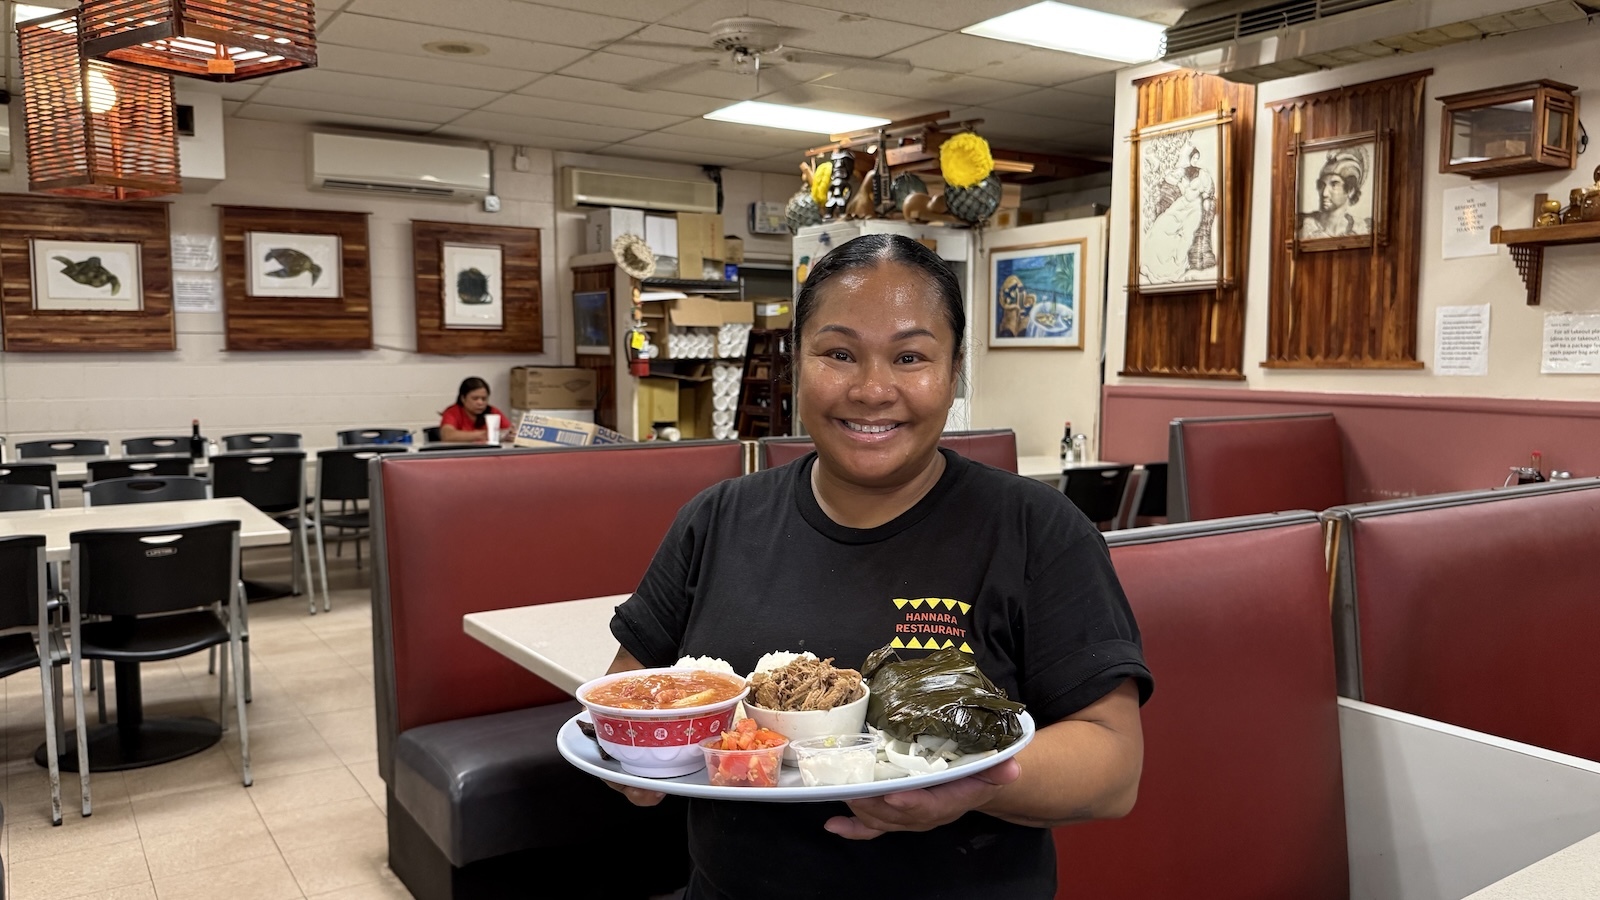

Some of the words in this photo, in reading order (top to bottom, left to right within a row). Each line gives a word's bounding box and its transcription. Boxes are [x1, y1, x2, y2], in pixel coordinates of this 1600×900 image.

[518, 424, 545, 439] 26490
[906, 613, 957, 625] HANNARA
[896, 624, 966, 638] RESTAURANT
